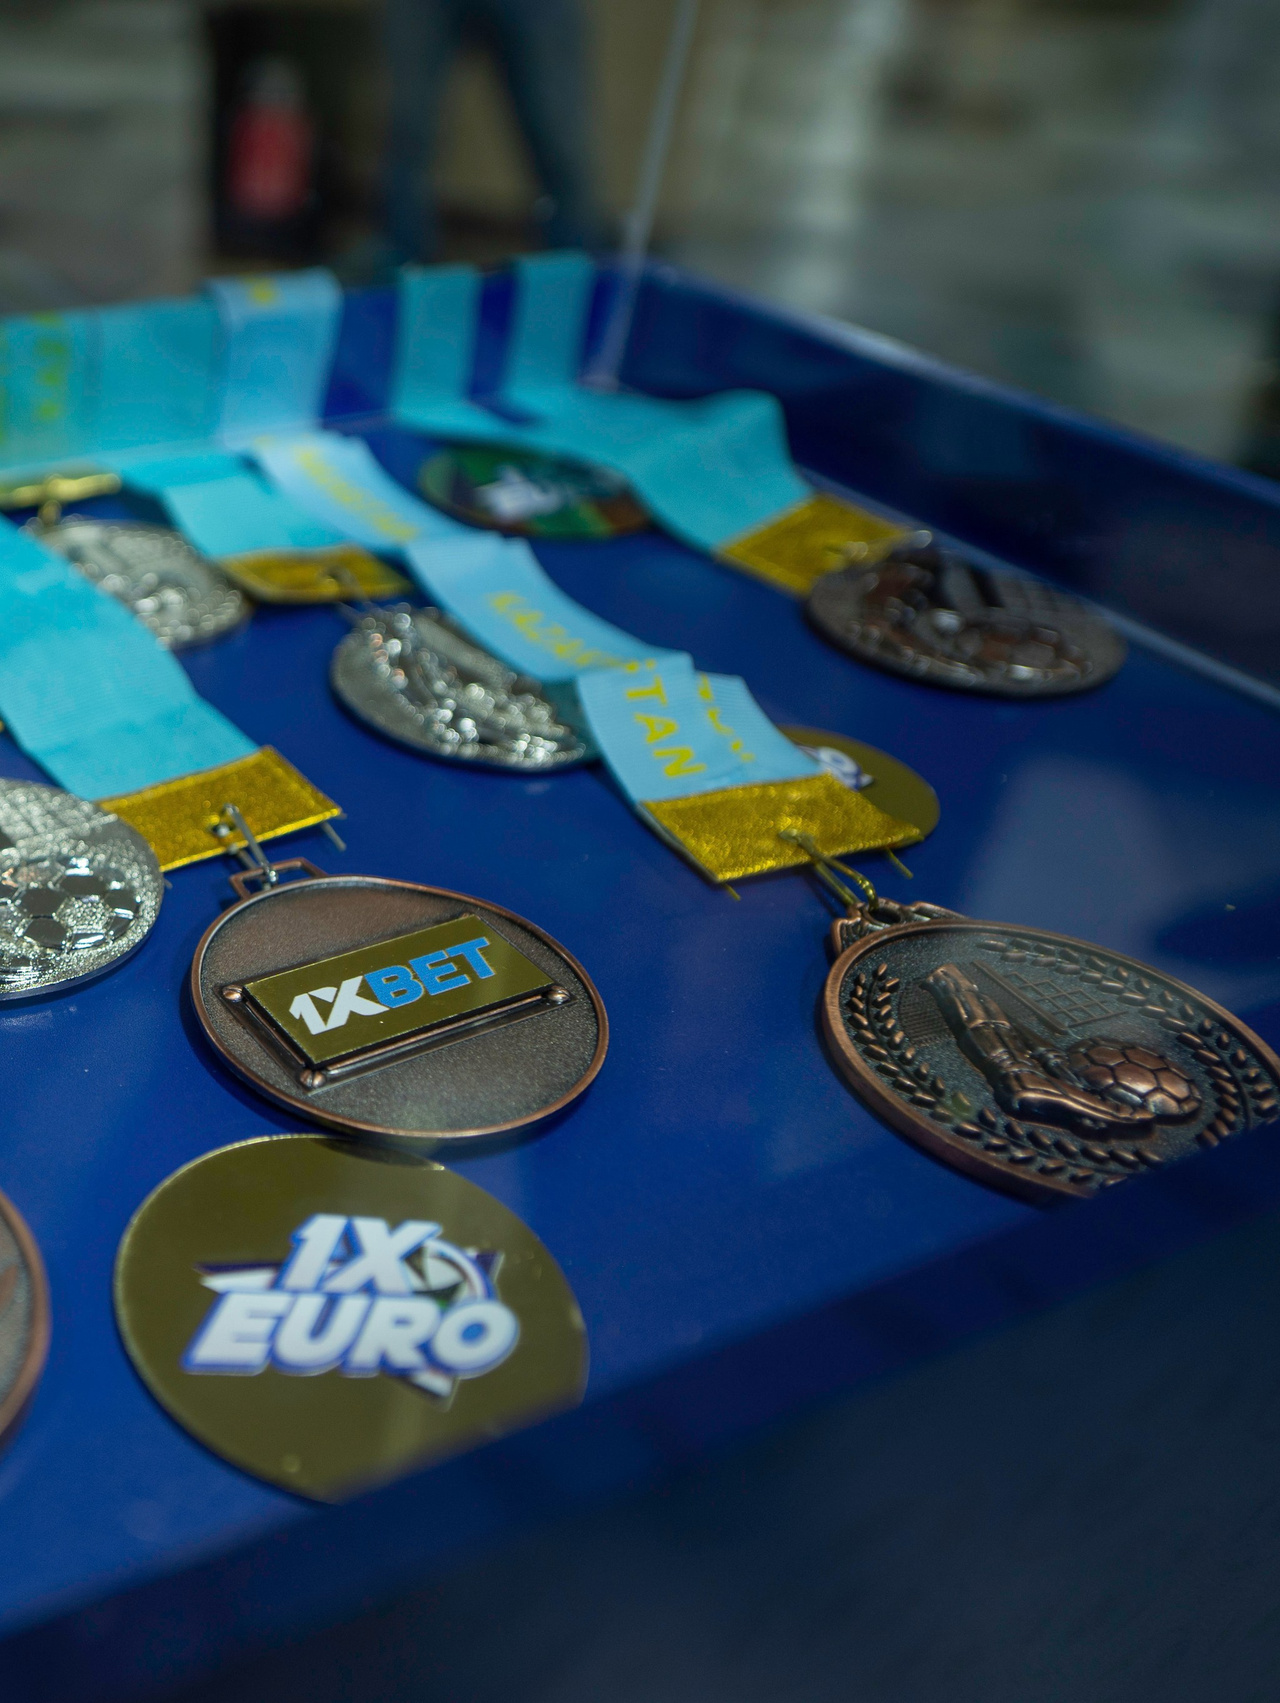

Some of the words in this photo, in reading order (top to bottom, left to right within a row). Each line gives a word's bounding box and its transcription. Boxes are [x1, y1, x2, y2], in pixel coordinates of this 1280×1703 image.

[288, 936, 497, 1036] 1XBET
[272, 1212, 444, 1294] 1X
[179, 1289, 520, 1379] EURO
